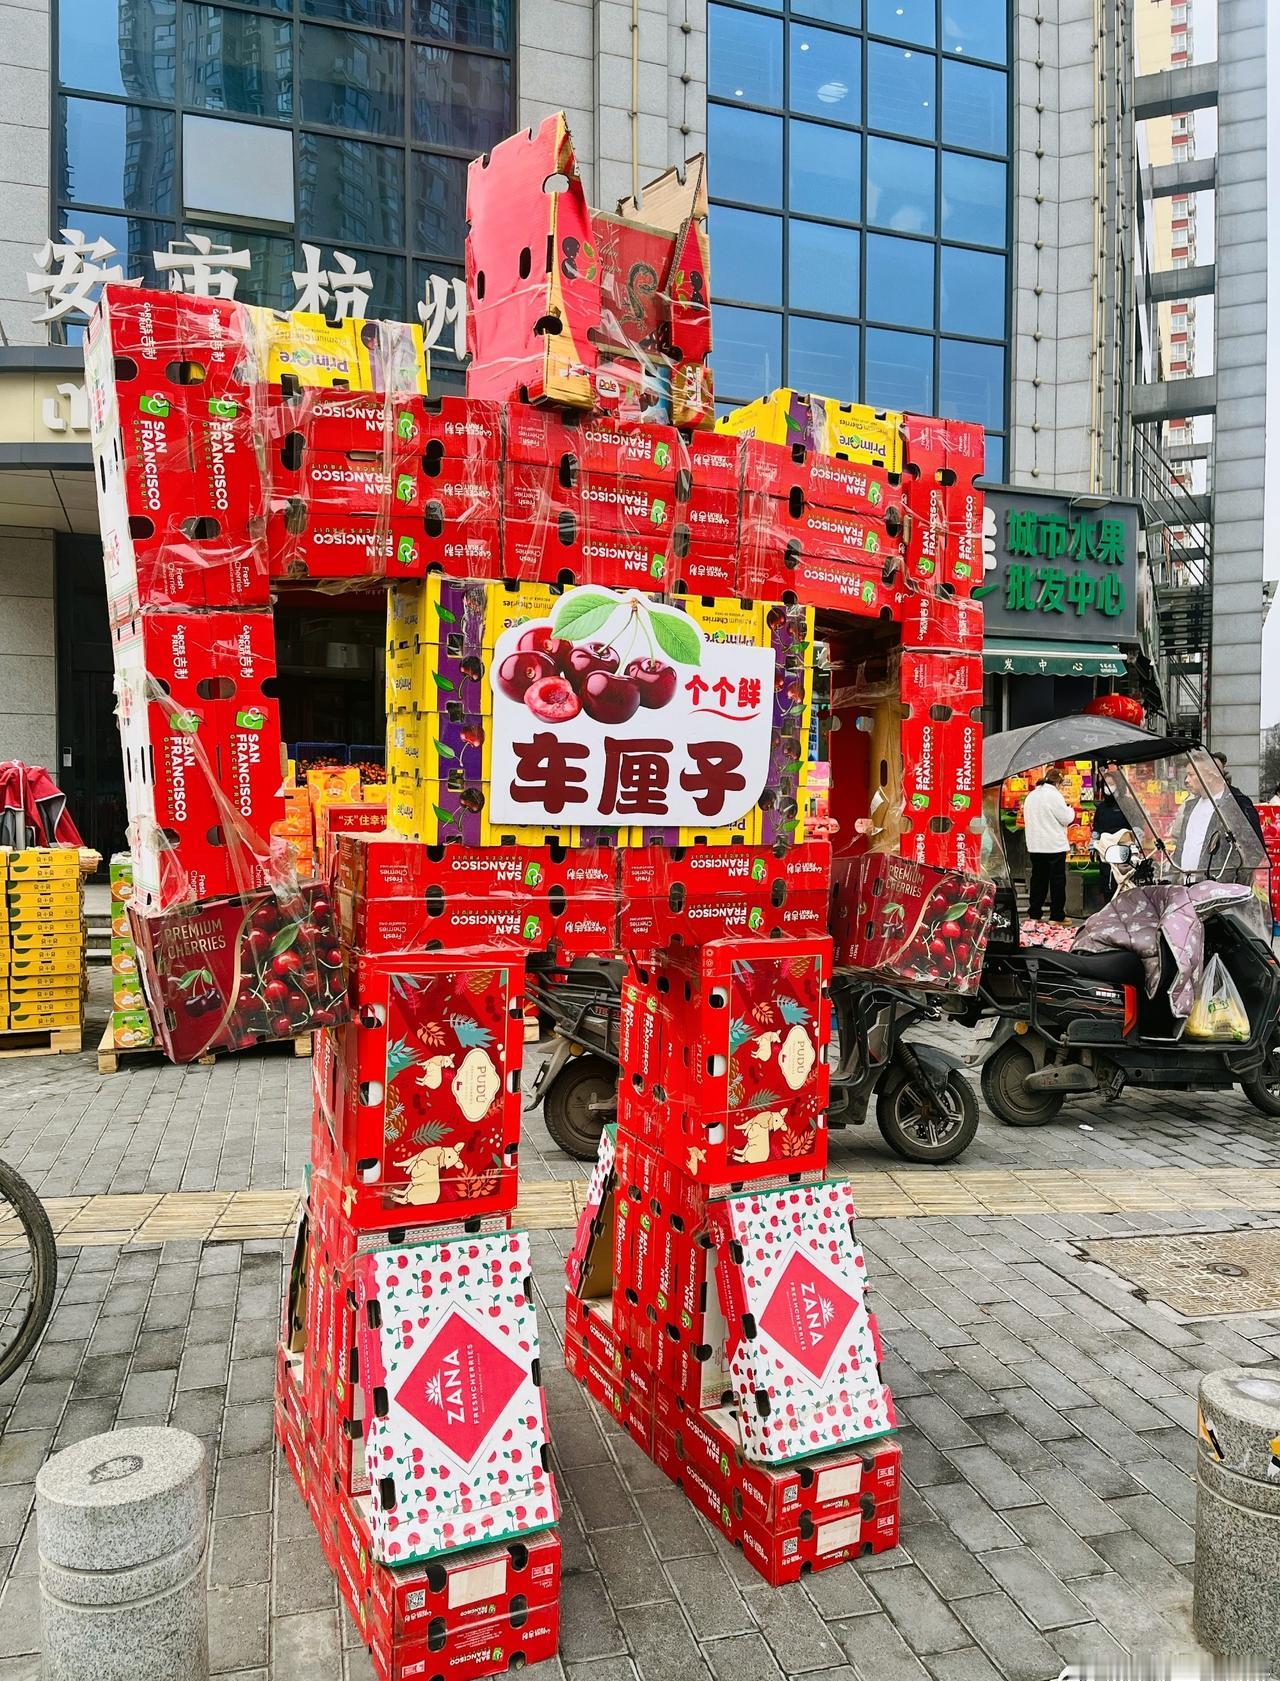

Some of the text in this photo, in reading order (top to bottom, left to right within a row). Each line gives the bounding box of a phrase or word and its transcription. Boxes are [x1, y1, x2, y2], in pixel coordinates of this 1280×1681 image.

[138, 311, 146, 335] FRUIT
[144, 302, 154, 334] GARCES
[600, 379, 617, 391] Dole
[312, 405, 394, 421] FRANCISCO
[366, 420, 393, 432] SAN
[154, 420, 168, 454] SAN
[222, 422, 236, 454] SAN
[585, 430, 652, 449] FRANCISCO
[628, 447, 652, 460] SAN
[140, 420, 161, 511] FRANCISCO
[209, 422, 229, 511] FRANCISCO
[311, 469, 392, 484] FRANCISCO
[810, 467, 868, 488] FRANCISCO
[364, 483, 392, 495] SAN
[581, 489, 649, 508] FRANCISCO
[845, 484, 866, 497] SAN
[624, 506, 648, 517] SAN
[807, 518, 864, 538] FRANCISCO
[929, 490, 937, 556] FRANCISCO
[965, 495, 973, 561] FRANCISCO
[313, 534, 394, 546] FRANCISCO
[843, 534, 864, 547] SAN
[922, 531, 930, 555] SAN
[1006, 505, 1126, 566] 城市水果
[366, 546, 394, 557] SAN
[515, 549, 542, 558] Cherries
[519, 555, 537, 564] Fresh
[582, 545, 648, 562] FRANCISCO
[624, 560, 648, 571] SAN
[167, 563, 177, 595] Cherries
[177, 568, 185, 590] Fresh
[234, 561, 243, 593] Cherries
[242, 566, 251, 588] Fresh
[803, 569, 861, 589] FRANCISCO
[839, 584, 860, 597] SAN
[1005, 563, 1127, 617] 批发中心
[503, 600, 534, 609] Cherries
[702, 616, 729, 625] Cherries
[176, 625, 187, 655] GARCES
[243, 625, 253, 656] GARCES
[684, 673, 761, 709] 个个鲜
[182, 737, 196, 767] SAN
[230, 734, 239, 779] GARCES
[248, 733, 261, 763] SAN
[923, 726, 931, 791] FRANCISCO
[963, 727, 972, 791] FRANCISCO
[170, 737, 188, 822] FRANCISCO
[236, 734, 252, 817] FRANCISCO
[509, 731, 747, 816] 车厘子
[916, 767, 924, 791] SAN
[956, 768, 964, 791] SAN
[379, 868, 408, 876] Cherries
[451, 860, 522, 871] FRANCISCO
[690, 858, 750, 869] FRANCISCO
[728, 867, 749, 877] SAN
[199, 874, 207, 896] Fresh
[384, 875, 403, 883] Fresh
[497, 871, 522, 881] SAN
[585, 872, 609, 881] GARCES
[889, 865, 925, 885] PREMIUM
[885, 878, 923, 898] CHERRIES
[451, 914, 521, 926] FRANCISCO
[688, 907, 747, 919] FRANCISCO
[725, 916, 746, 926] SAN
[164, 918, 223, 943] PREMIUM
[378, 925, 407, 933] Cherries
[495, 925, 520, 935] SAN
[630, 920, 653, 928] Cherries
[633, 926, 649, 934] Fresh
[383, 931, 402, 940] Fresh
[167, 936, 226, 960] CHERRIES
[662, 1232, 671, 1296] FRANCISCO
[688, 1248, 696, 1314] FRANCISCO
[723, 1260, 736, 1322] FRESHCHERRIES
[789, 1281, 807, 1351] FRESHCHERRIES
[800, 1282, 824, 1347] ZANA
[442, 1348, 466, 1425] ZANA
[466, 1343, 480, 1425] FRESHCHERRIES
[685, 1417, 720, 1455] FRANCISCO
[706, 1446, 720, 1464] SAN
[686, 1465, 721, 1504] FRANCISCO
[707, 1495, 721, 1514] SAN
[449, 1649, 491, 1666] FRANCISCO
[475, 1655, 491, 1665] SAN
